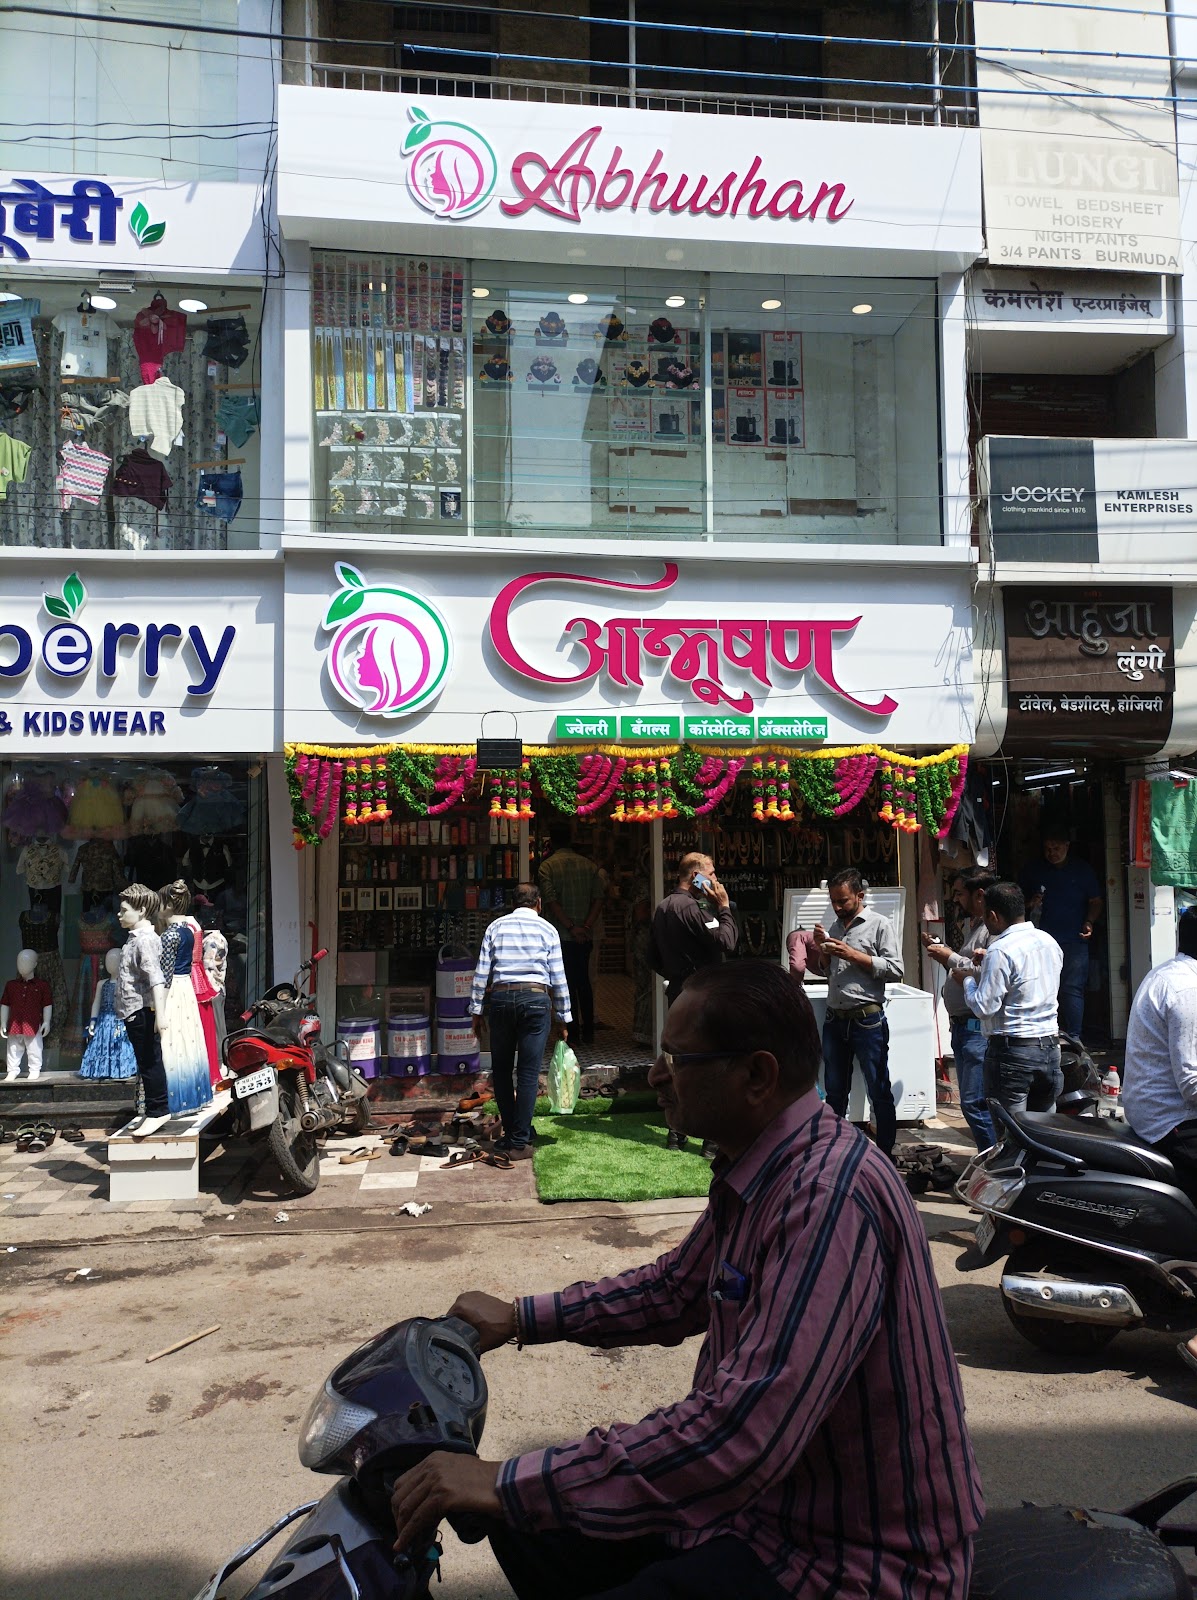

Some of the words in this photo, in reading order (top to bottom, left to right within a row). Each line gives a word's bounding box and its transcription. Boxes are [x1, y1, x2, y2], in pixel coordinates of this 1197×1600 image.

[500, 125, 855, 222] Abhushan
[1005, 147, 1161, 191] LUNGI
[1005, 195, 1063, 209] TOWEL
[1077, 199, 1164, 215] BEDSHEET
[1052, 214, 1123, 229] HOISERY
[1035, 231, 1138, 247] NIGHTPANTS
[1000, 246, 1023, 258] 3/4
[1028, 246, 1081, 260] PANTS
[1095, 250, 1179, 267] BURMUDA
[982, 282, 1064, 312] कमलेश
[1002, 486, 1085, 503] JOCKEY
[1117, 491, 1179, 501] KAMLESH
[1104, 503, 1193, 514] ENTERPRISES
[1026, 600, 1158, 655] आहुजा
[489, 563, 898, 715] आभूषण
[1117, 645, 1166, 681] लुंगी
[1117, 694, 1163, 713] होजियरी
[565, 718, 608, 736] ज्वेलरी
[688, 719, 751, 736] कॉस्मेटिक
[239, 1076, 272, 1094] 2253
